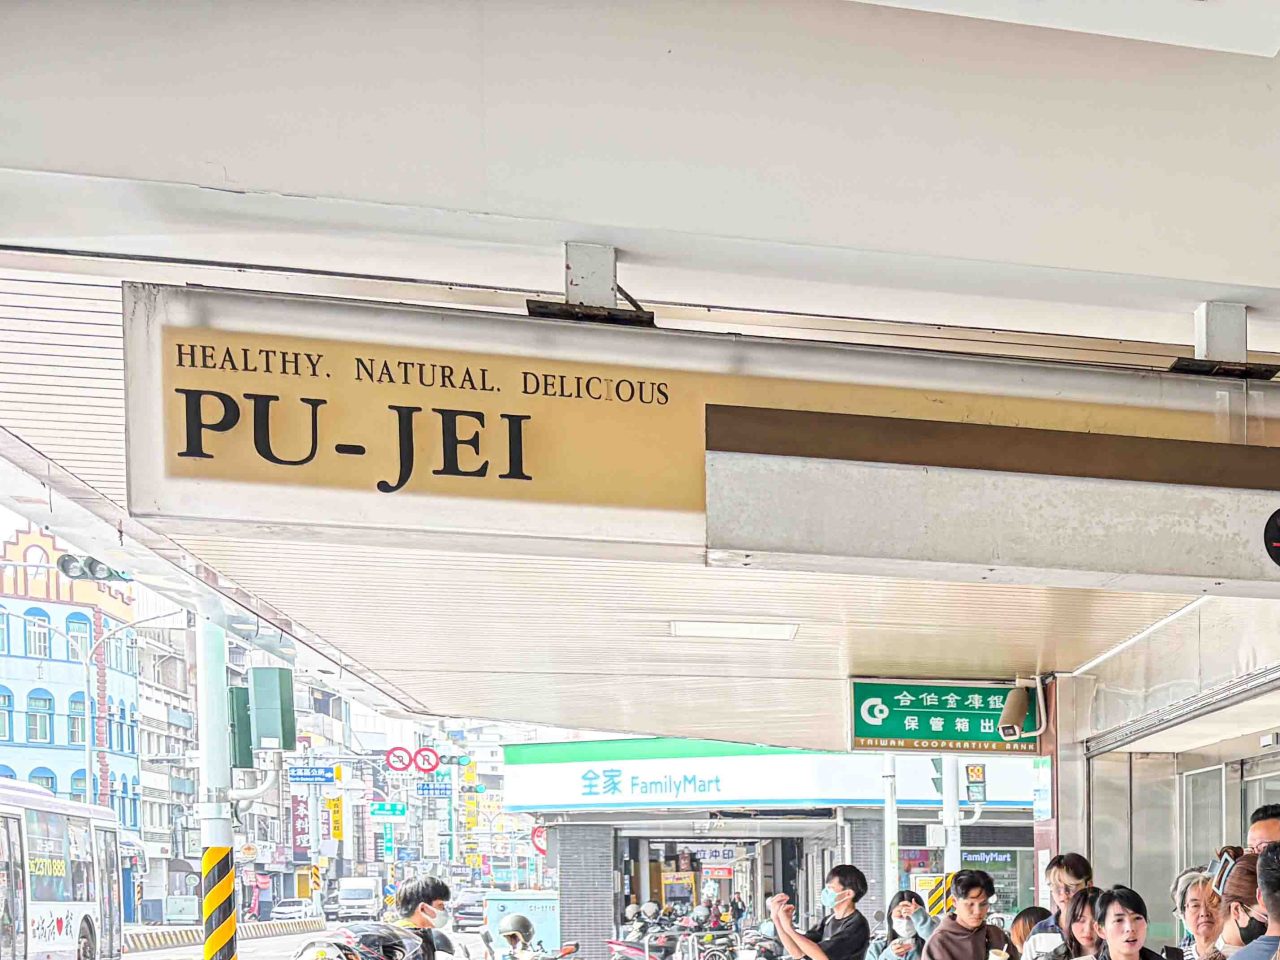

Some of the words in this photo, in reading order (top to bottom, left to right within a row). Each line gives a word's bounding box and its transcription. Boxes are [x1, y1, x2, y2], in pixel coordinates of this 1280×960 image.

[176, 343, 331, 378] HEALTHY.
[355, 357, 502, 393] NATURAL.
[521, 371, 670, 406] DELICIOUS
[173, 387, 533, 494] PU-JEI
[860, 739, 905, 747] TAIWAN
[914, 740, 997, 750] COOPERATIVE
[581, 769, 622, 796] 全家
[630, 774, 721, 798] FamilyMart
[962, 853, 1011, 863] FamilyMart
